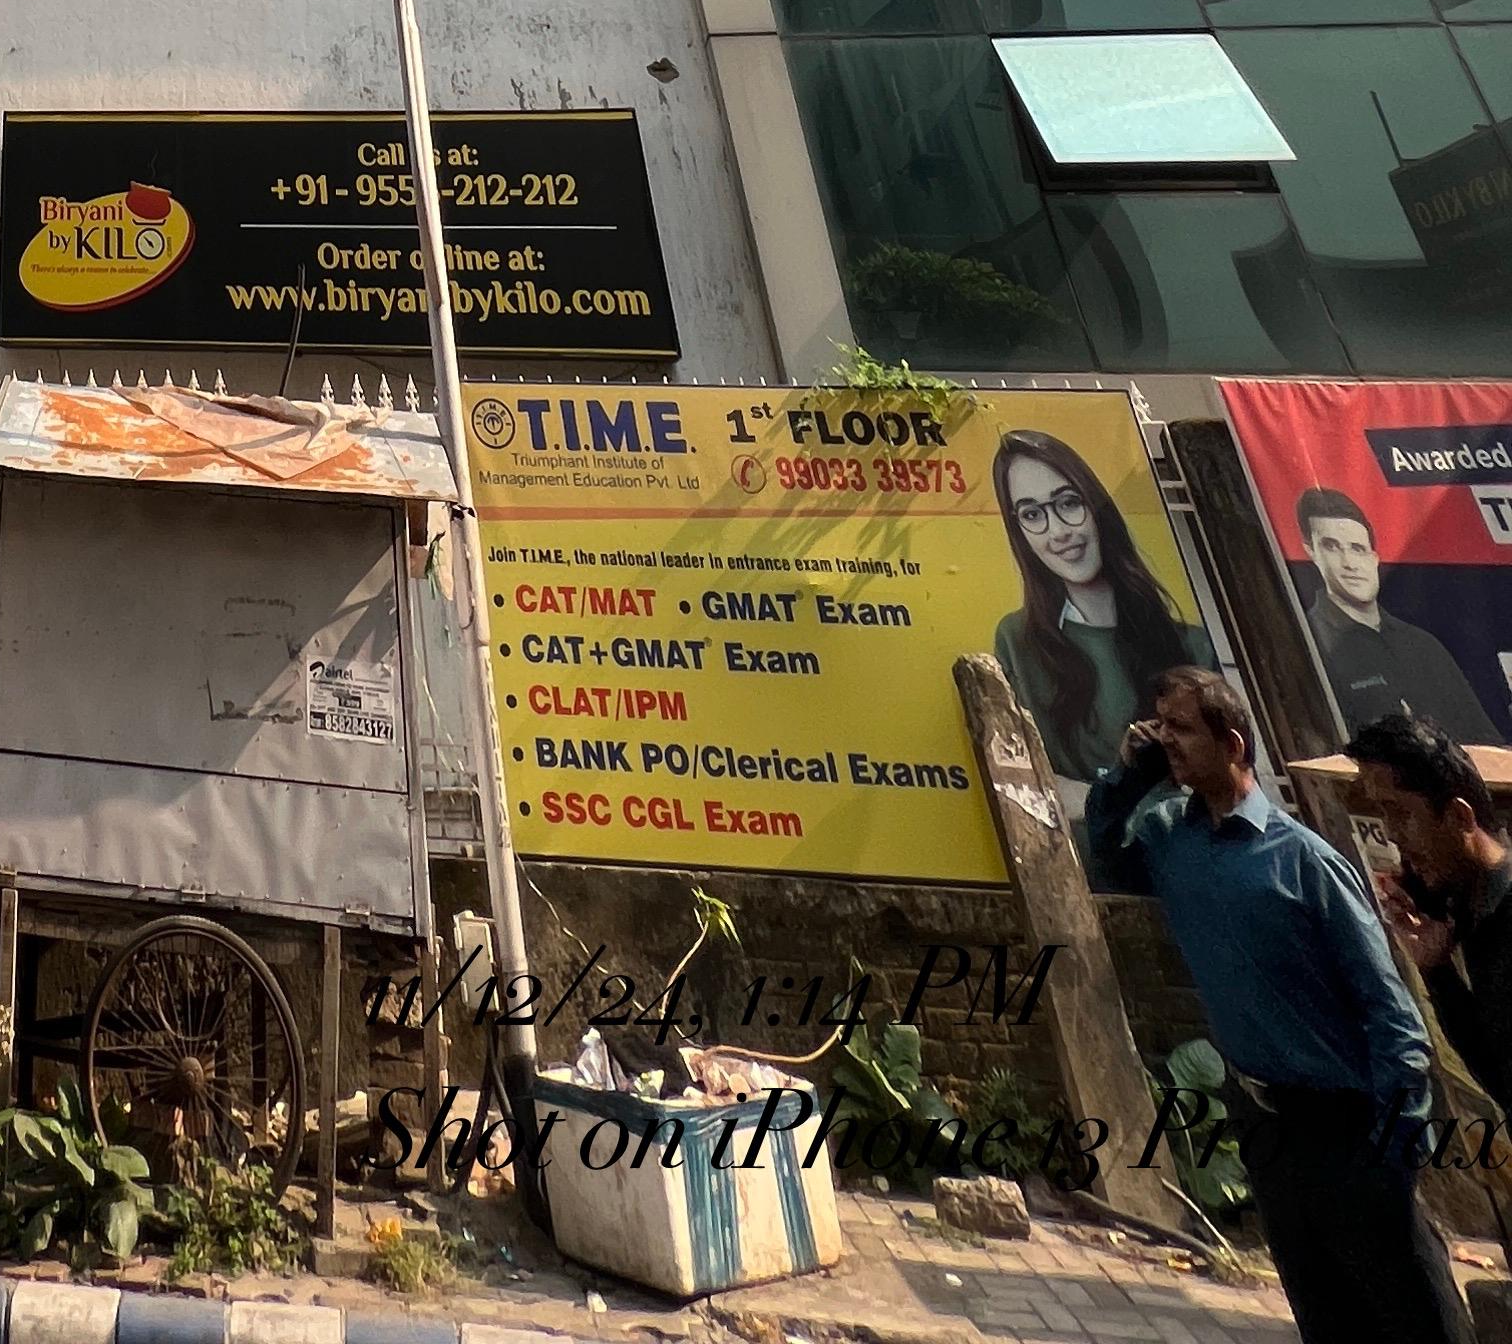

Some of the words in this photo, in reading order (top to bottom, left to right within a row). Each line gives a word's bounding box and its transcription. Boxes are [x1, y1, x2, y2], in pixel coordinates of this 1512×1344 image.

[357, 142, 406, 166] Call
[447, 143, 480, 166] at:
[355, 172, 579, 206] 955-212-212
[42, 198, 125, 227] Biryani
[47, 229, 72, 254] by
[73, 226, 166, 261] KILO
[316, 241, 402, 271] Order
[409, 243, 500, 272] oline
[507, 245, 546, 271] at:
[225, 278, 652, 323] www.biryanbykilo.com
[517, 398, 698, 453] T.I.M.E.
[725, 401, 775, 444] 1st
[787, 409, 949, 447] FLOOR
[511, 452, 589, 470] Triumphant
[592, 454, 648, 470] Institute
[650, 456, 666, 470] of
[1391, 441, 1512, 473] Awarded
[478, 470, 569, 490] Management
[572, 471, 642, 489] Education
[774, 455, 868, 493] 99033
[872, 457, 968, 495] 39573
[1478, 496, 1512, 532] T
[488, 545, 517, 563] Join
[573, 548, 597, 566] the
[599, 549, 659, 568] national
[660, 551, 706, 570] leader
[727, 552, 792, 572] entrance
[793, 557, 834, 574] exam
[836, 556, 899, 578] training,
[899, 558, 922, 576] for
[514, 583, 658, 620] CAT/MAT
[814, 594, 913, 627] Exam
[325, 665, 354, 681] airtel
[723, 641, 822, 675] Exam
[527, 684, 689, 722] CLAT/IPM
[324, 713, 393, 740] 8582843127
[534, 736, 634, 773] BANK
[639, 742, 839, 784] PO/Clerical
[846, 753, 971, 791] Exams
[541, 791, 612, 828] SSC
[621, 795, 696, 831] CGL
[702, 800, 804, 838] Exam
